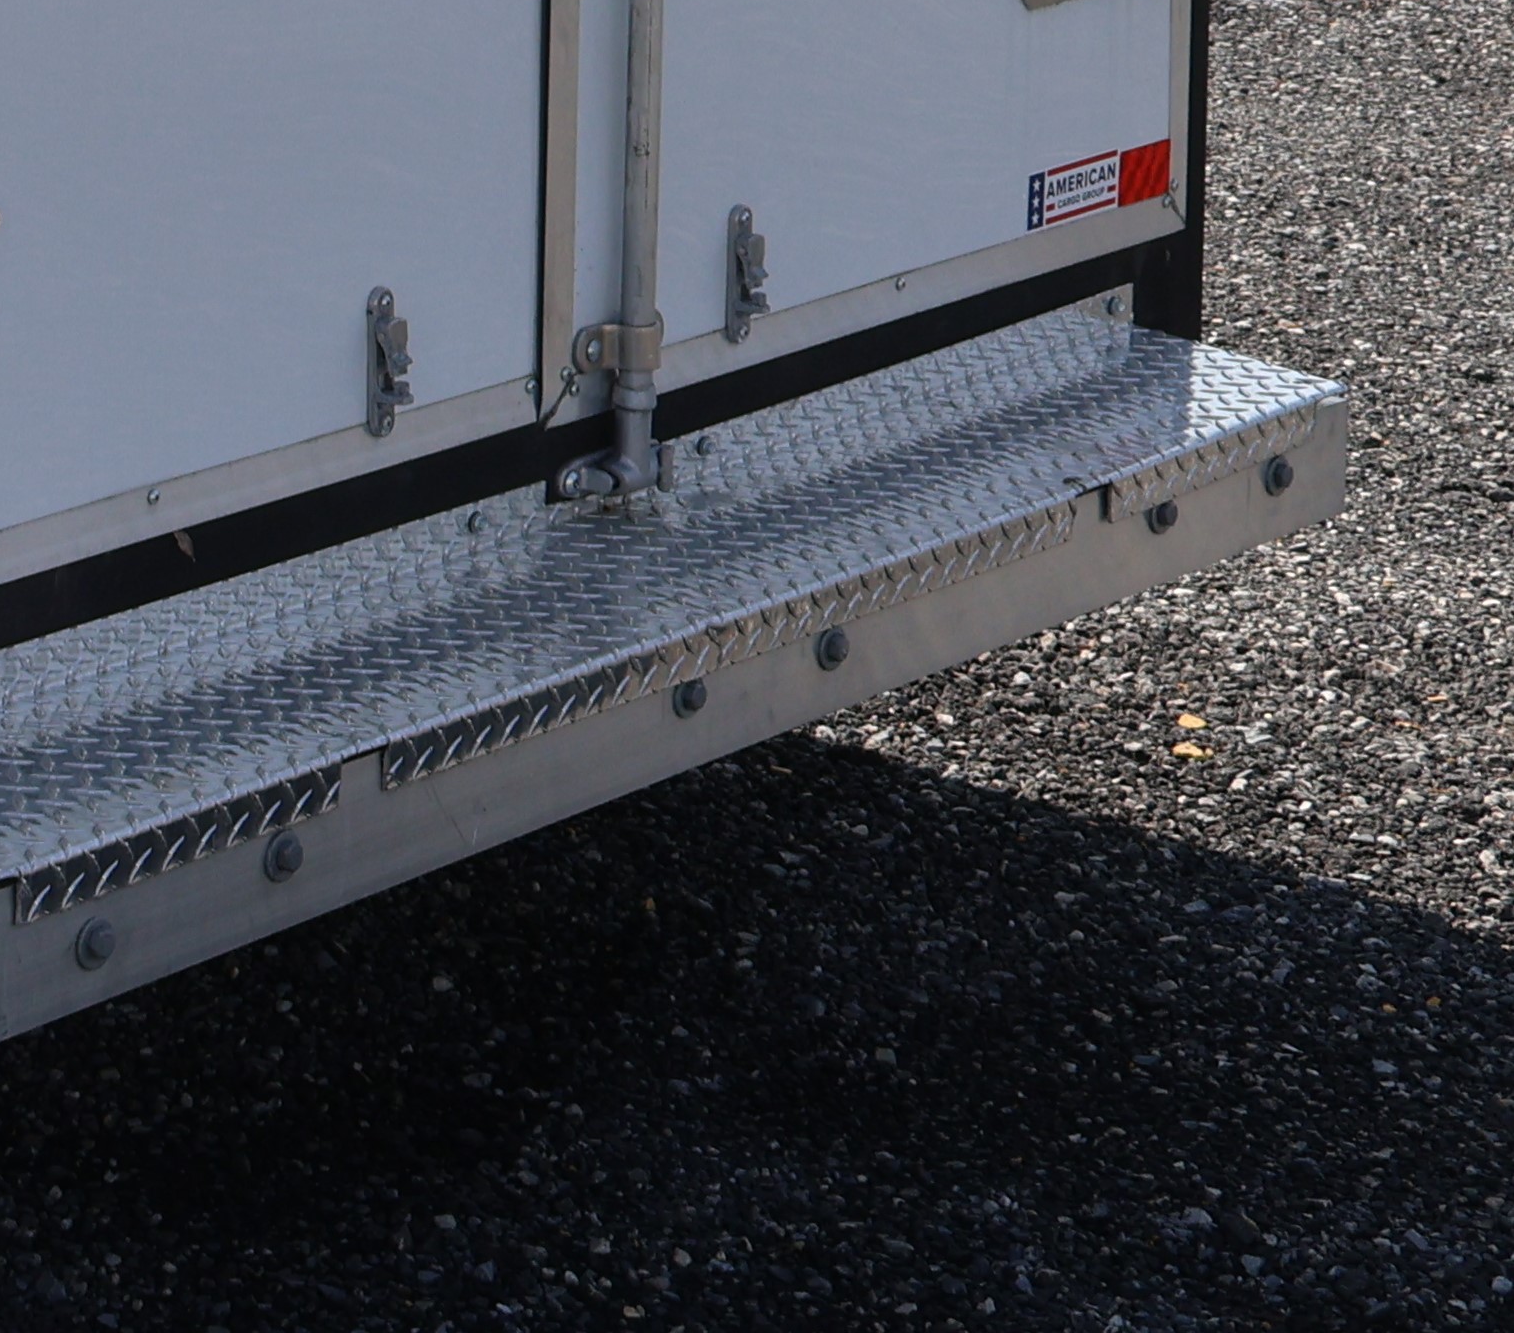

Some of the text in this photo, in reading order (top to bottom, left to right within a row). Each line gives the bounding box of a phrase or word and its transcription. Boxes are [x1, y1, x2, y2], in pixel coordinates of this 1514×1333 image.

[1046, 162, 1117, 199] AMERICAN
[1057, 186, 1105, 209] CARGO GROUP
